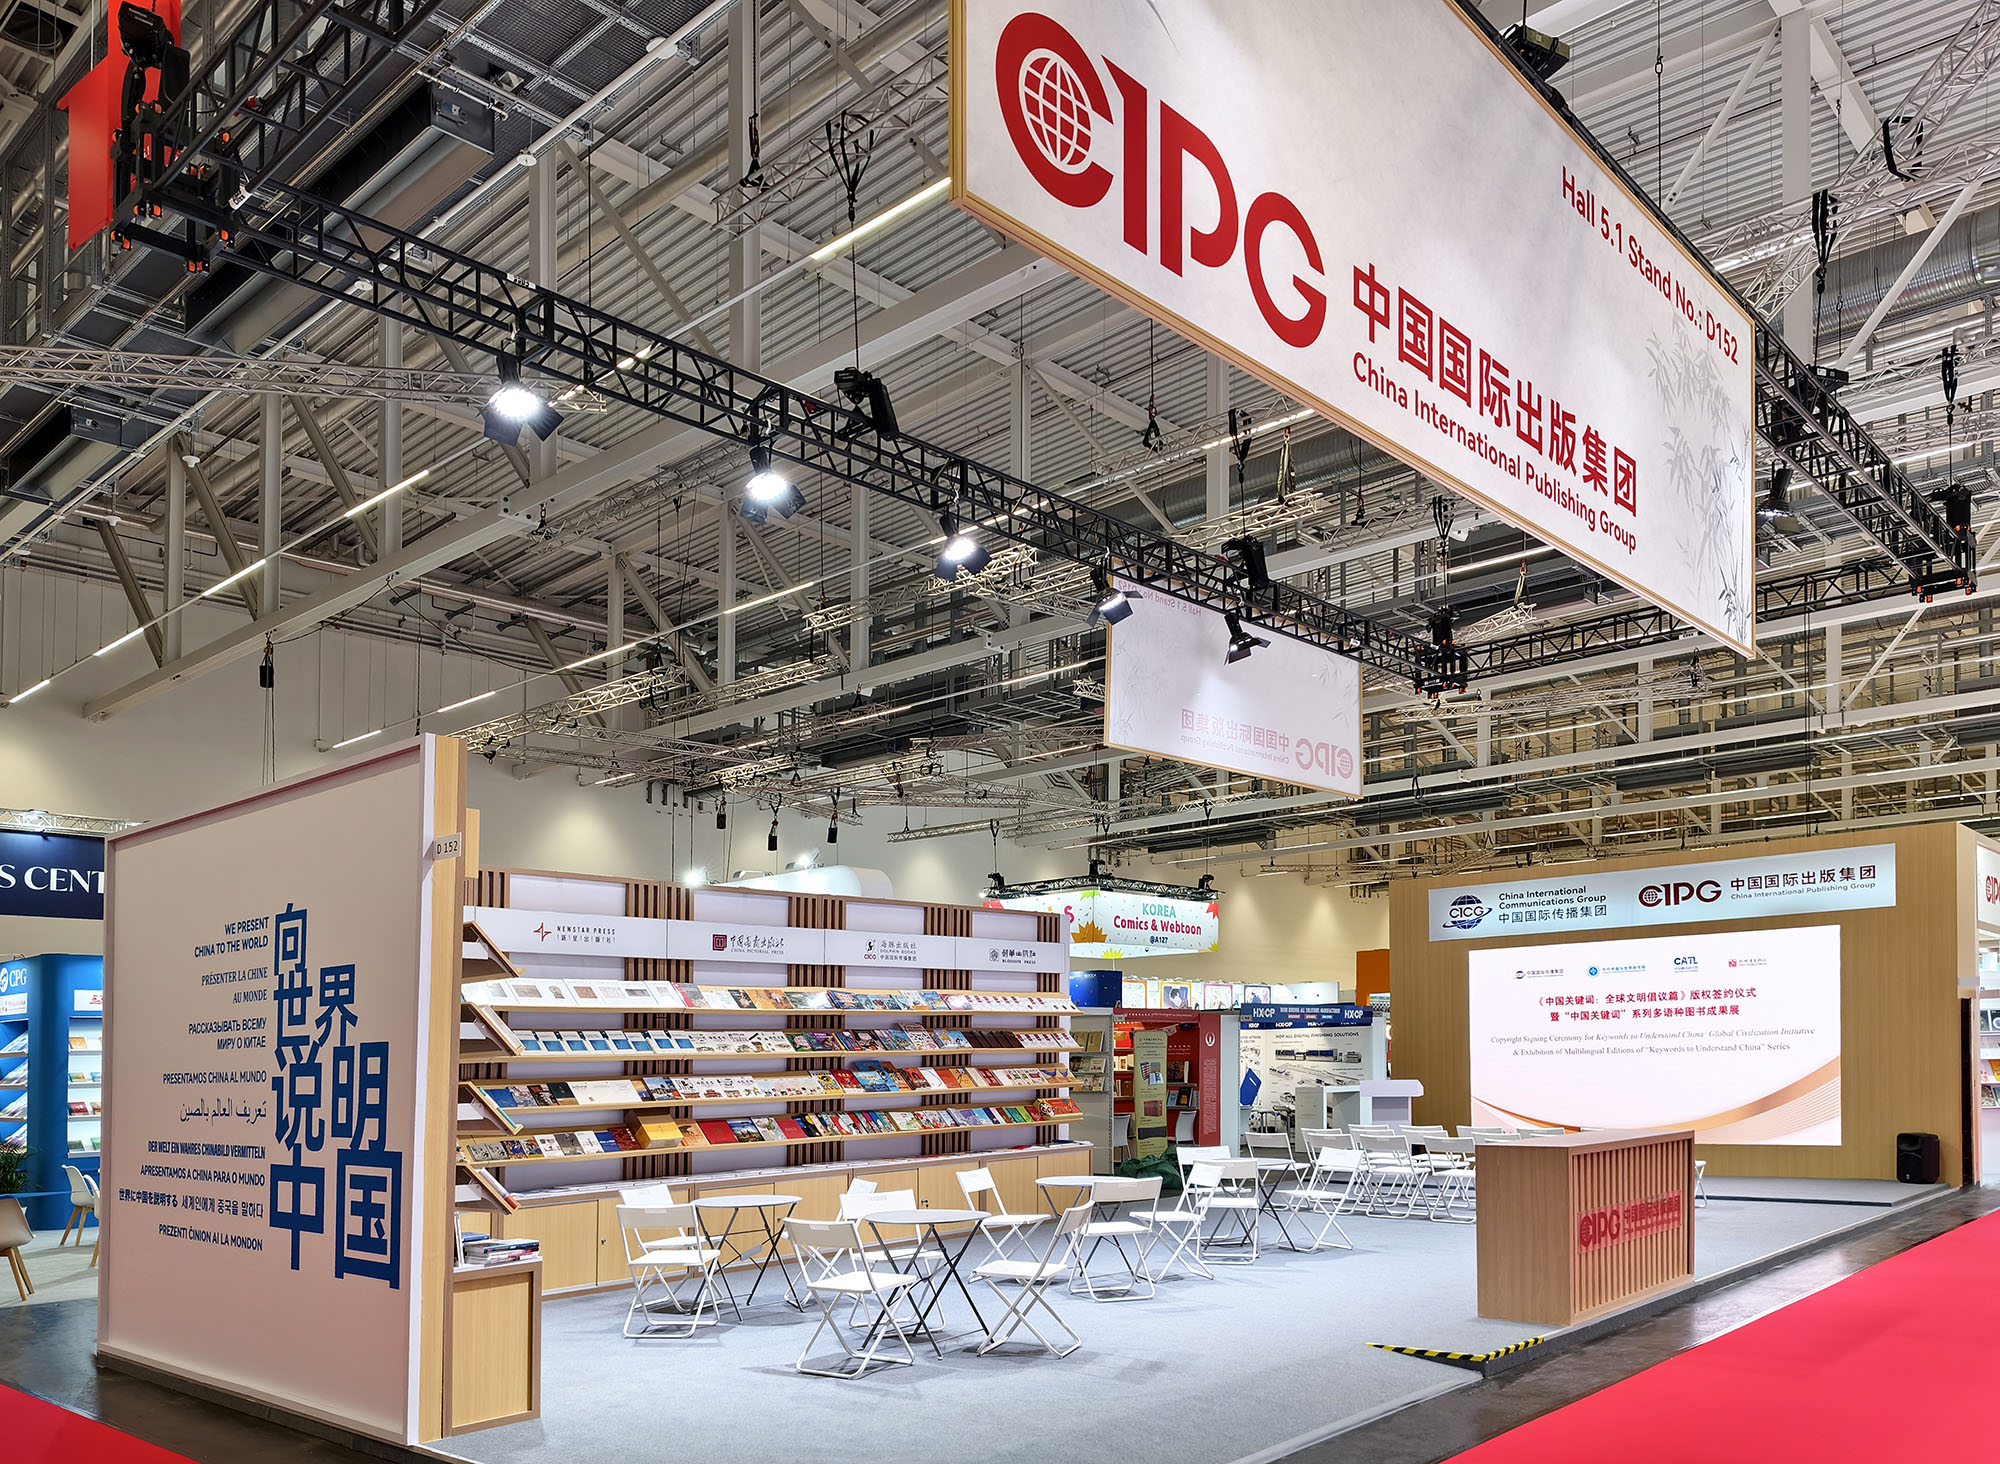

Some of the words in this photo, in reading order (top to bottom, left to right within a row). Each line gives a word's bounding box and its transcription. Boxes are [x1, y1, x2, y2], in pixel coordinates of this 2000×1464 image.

[995, 12, 1327, 348] CIPG
[1562, 166, 1595, 227] Hall
[1601, 206, 1622, 254] 5.1
[1628, 235, 1671, 300] Stand
[1675, 280, 1702, 330] No.:
[1706, 310, 1738, 365] D152
[1353, 262, 1637, 518] 中国国际出版集团
[1353, 352, 1408, 409] China
[1415, 389, 1520, 480] International
[1526, 461, 1596, 532] Publishing
[1600, 510, 1637, 555] Group
[444, 841, 458, 853] 152
[1730, 865, 1877, 892] 中国国际出版集团
[1498, 892, 1524, 901] China
[1526, 885, 1587, 899] International
[1638, 880, 1723, 908] CIPG
[1730, 892, 1753, 901] China
[1754, 887, 1805, 899] International
[1806, 884, 1848, 895] Publishing
[1849, 882, 1876, 891] Group
[1986, 875, 2000, 904] CIP
[1142, 903, 1177, 919] KOREA
[1498, 895, 1575, 910] Communications
[1576, 893, 1607, 905] Group
[1449, 906, 1484, 919] CICG
[1498, 904, 1607, 925] 中国国际传播集团
[224, 923, 236, 935] WE
[237, 916, 269, 933] PRESENT
[557, 926, 591, 934] NEWSTAR
[593, 927, 616, 935] PRESS
[1113, 915, 1149, 931] Comics
[1150, 919, 1159, 932] &
[1160, 919, 1202, 936] Webtoon
[194, 944, 215, 958] CHINA
[216, 943, 226, 954] TO
[227, 939, 240, 952] THE
[241, 935, 269, 950] WORLD
[1149, 935, 1169, 945] @A127
[1674, 956, 1699, 966] CATL
[9, 968, 27, 987] CPG
[201, 970, 237, 986] PRÉSENTER
[238, 970, 247, 981] LA
[247, 967, 268, 981] CHINE
[232, 993, 242, 1004] AU
[243, 989, 268, 1002] MONDE
[188, 1021, 241, 1035] РАССКАЗЫВАТЬ
[242, 1017, 267, 1031] ВСЕМУ
[1490, 1036, 1522, 1044] Copyright
[1523, 1035, 1548, 1044] Signing
[1548, 1034, 1583, 1044] Ceremony
[1595, 1033, 1630, 1042] Keywords
[1640, 1031, 1680, 1041] Understand
[1682, 1030, 1706, 1039] China
[1709, 1029, 1734, 1038] Global
[1735, 1028, 1779, 1037] Civilization
[1780, 1027, 1815, 1035] Initiative
[217, 1038, 235, 1050] МИРУ
[236, 1037, 242, 1049] О
[243, 1035, 266, 1048] КИТАЕ
[1520, 1048, 1555, 1056] Exhibition
[1564, 1047, 1605, 1056] Multilingual
[1606, 1047, 1635, 1055] Editions
[1635, 1046, 1644, 1054] of
[1695, 1044, 1737, 1052] Understand
[1767, 1042, 1790, 1050] Series
[163, 1072, 207, 1084] PRESENTAMOS
[208, 1072, 229, 1084] CHINA
[229, 1071, 239, 1083] AL
[240, 1070, 267, 1083] MUNDO
[180, 1098, 210, 1122] بالصين
[211, 1098, 233, 1126] العالم
[235, 1100, 267, 1125] تعريف
[148, 1141, 158, 1153] DER
[158, 1141, 171, 1153] WELT
[171, 1142, 180, 1154] EIN
[179, 1143, 201, 1155] WAHRES
[201, 1143, 230, 1157] CHINABILD
[230, 1145, 266, 1159] VERMITTELN
[140, 1164, 186, 1180] APRESENTAMOS
[186, 1168, 192, 1180] A
[192, 1169, 213, 1181] CHINA
[213, 1170, 231, 1183] PARA
[231, 1172, 237, 1184] O
[238, 1173, 265, 1187] MUNDO
[181, 1194, 215, 1213] 세계인에게
[218, 1199, 239, 1216] 중국을
[241, 1201, 264, 1219] 말하다
[159, 1224, 188, 1240] PREZENTI
[220, 1233, 230, 1246] LA
[230, 1234, 263, 1251] MONDON
[1580, 1210, 1621, 1247] CIPG
